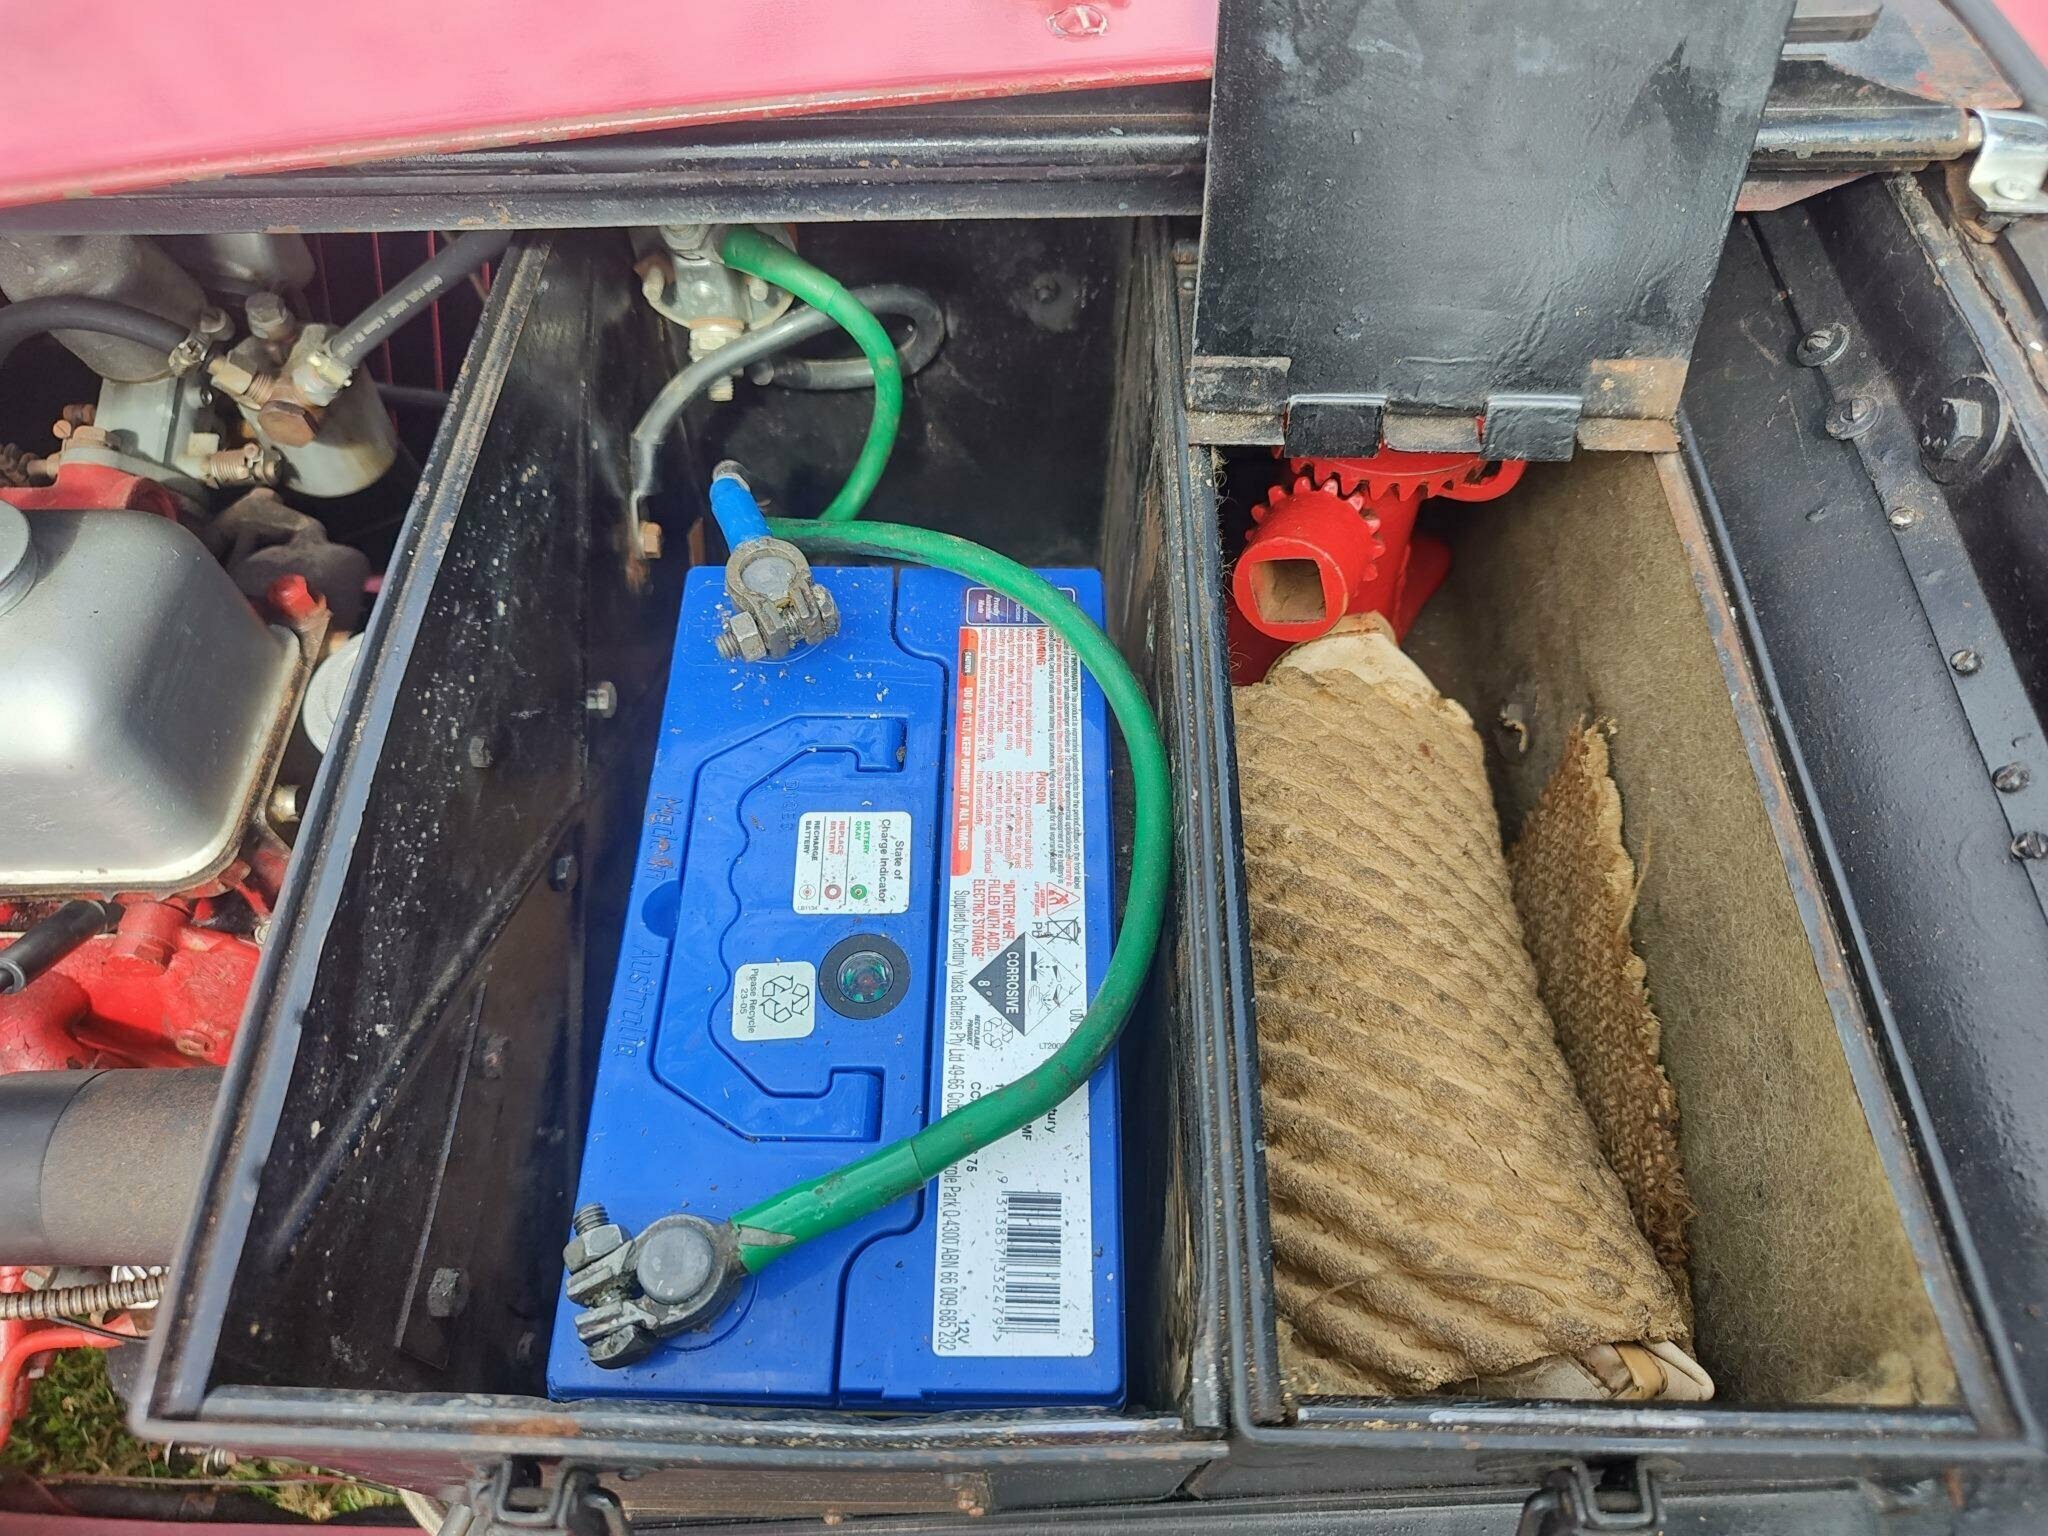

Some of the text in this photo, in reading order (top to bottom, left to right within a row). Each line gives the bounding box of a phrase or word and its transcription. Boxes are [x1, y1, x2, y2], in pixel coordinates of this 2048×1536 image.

[1037, 628, 1046, 666] WARNING
[964, 687, 973, 698] DO
[963, 700, 973, 713] NOT
[1071, 704, 1079, 721] product
[978, 714, 986, 735] voltage
[1015, 720, 1023, 749] cigarettes
[962, 736, 972, 756] KEEP
[961, 758, 971, 792] UPRIGHT
[976, 771, 984, 784] help
[1025, 786, 1033, 808] battery
[1036, 771, 1046, 804] POISON
[960, 795, 970, 806] AT
[649, 795, 683, 849] Made
[960, 808, 969, 823] ALL
[1015, 806, 1023, 834] contacts
[803, 820, 812, 854] BATTERY
[811, 820, 820, 861] RECHARGE
[828, 821, 836, 855] BATTERY
[836, 821, 845, 855] REPLACE
[854, 821, 862, 841] OKAY
[959, 825, 969, 850] TIMES
[878, 819, 890, 903] Charge Indicator
[893, 840, 904, 880] State of
[1014, 852, 1022, 869] eyes
[1024, 839, 1033, 870] sulphuric
[973, 880, 985, 916] ELECTRIC
[988, 880, 1000, 905] FILLED
[952, 890, 968, 922] Supplied
[951, 925, 966, 936] by:
[987, 908, 1000, 929] WITH
[1032, 922, 1042, 938] Pb
[950, 938, 965, 967] Century
[951, 970, 964, 993] Yuasa
[1006, 952, 1020, 1014] CORROSIVE
[615, 947, 660, 1057] Australia
[739, 989, 748, 1014] 23-05
[747, 968, 759, 1034] Please Recycle
[950, 996, 964, 1030] Batteries
[946, 1033, 964, 1046] Pty
[948, 1049, 963, 1062] Ltd
[948, 1064, 962, 1089] 49-65
[971, 1082, 981, 1101] CC
[1045, 1109, 1057, 1133] tury
[967, 1159, 977, 1172] 75
[943, 1186, 960, 1207] Park
[942, 1209, 959, 1217] Q
[942, 1220, 959, 1244] 4300
[941, 1247, 959, 1268] ABN
[992, 1176, 1008, 1325] 9 313857 332479
[941, 1272, 958, 1283] 66
[940, 1287, 958, 1305] 009
[939, 1309, 957, 1328] 685
[938, 1331, 957, 1350] 232
[958, 1320, 970, 1344] 12V
